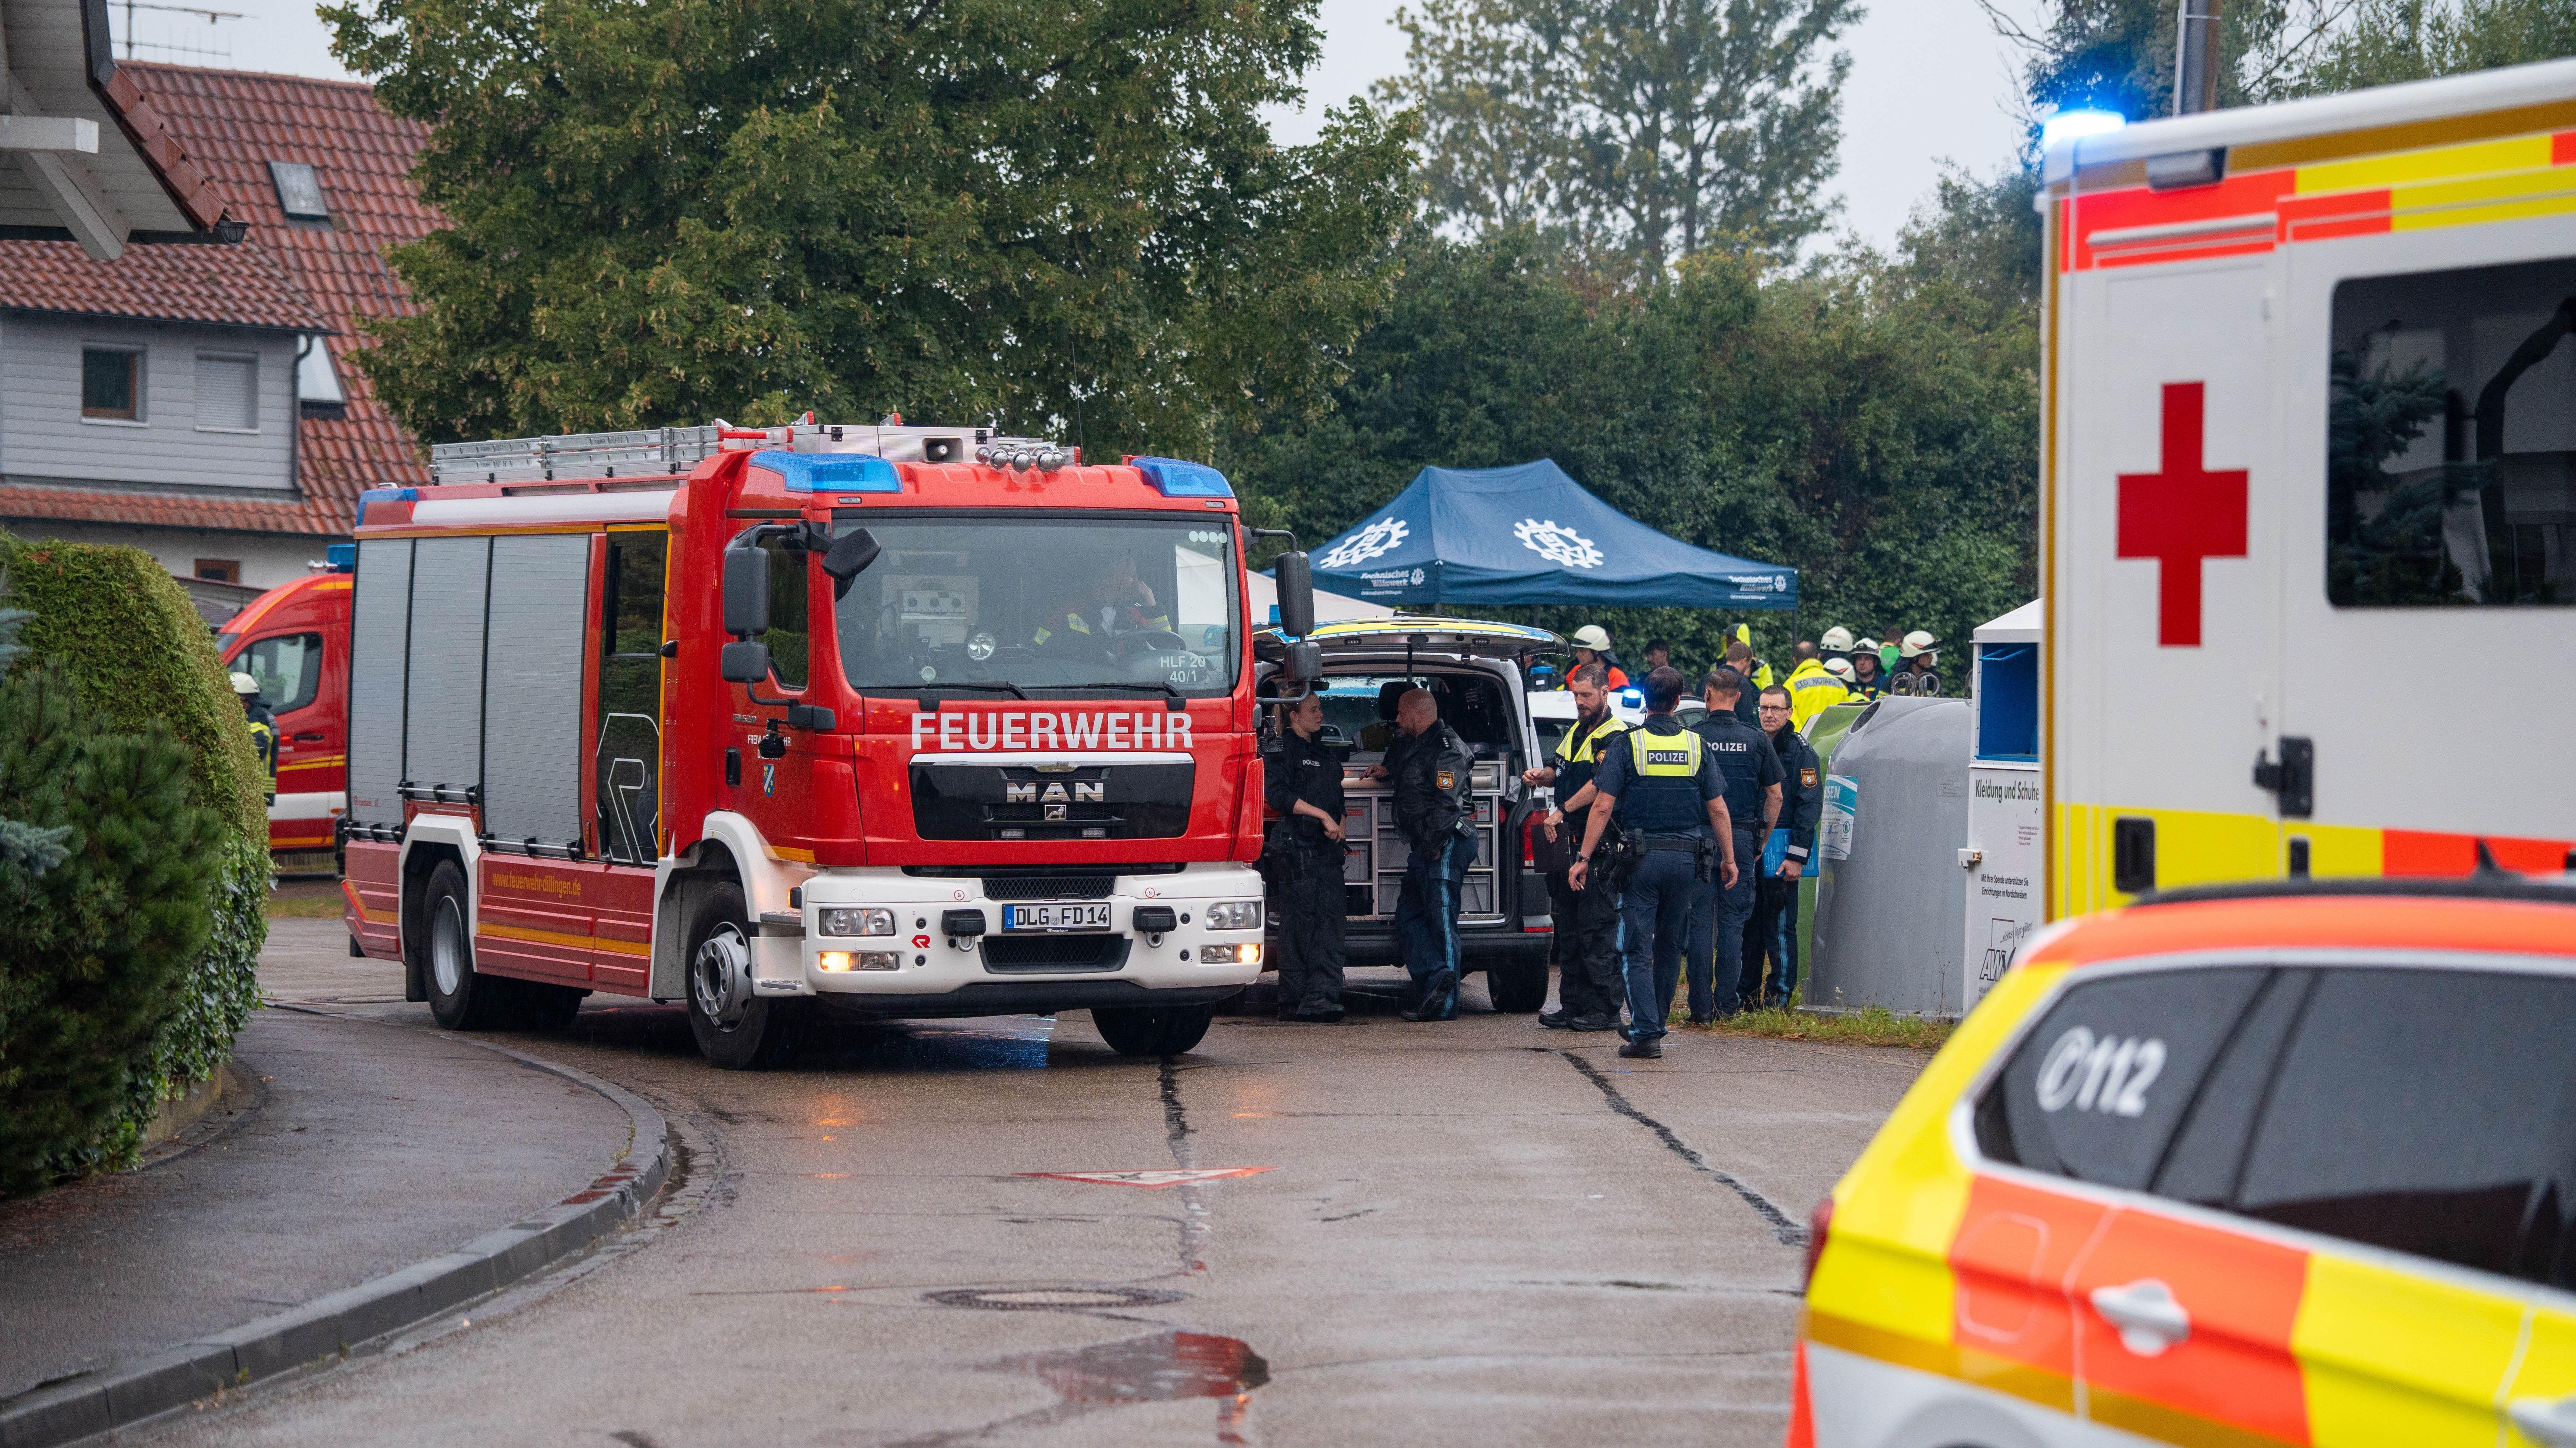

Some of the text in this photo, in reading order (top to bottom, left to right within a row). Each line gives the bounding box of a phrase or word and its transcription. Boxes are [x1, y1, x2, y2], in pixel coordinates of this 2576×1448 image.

[1160, 656, 1206, 668] HLF 20
[1170, 670, 1196, 684] 40/1
[912, 713, 1194, 749] FEUERWEHR
[1648, 752, 1687, 762] POLIZEI
[1006, 783, 1104, 802] MAN
[1976, 779, 2002, 803] Kleidung
[2004, 780, 2016, 799] und
[2018, 781, 2040, 801] Schuhe
[493, 871, 581, 898] www.feuerwehr-dillingen.de
[1994, 875, 2004, 885] Spende
[2005, 877, 2023, 886] unterstützen
[1982, 886, 2027, 899] Einrichtungen in Nordschwaben
[1016, 908, 1049, 925] DLG
[1061, 907, 1083, 925] FD
[1087, 906, 1108, 924] 14
[2076, 1035, 2167, 1117] 112
